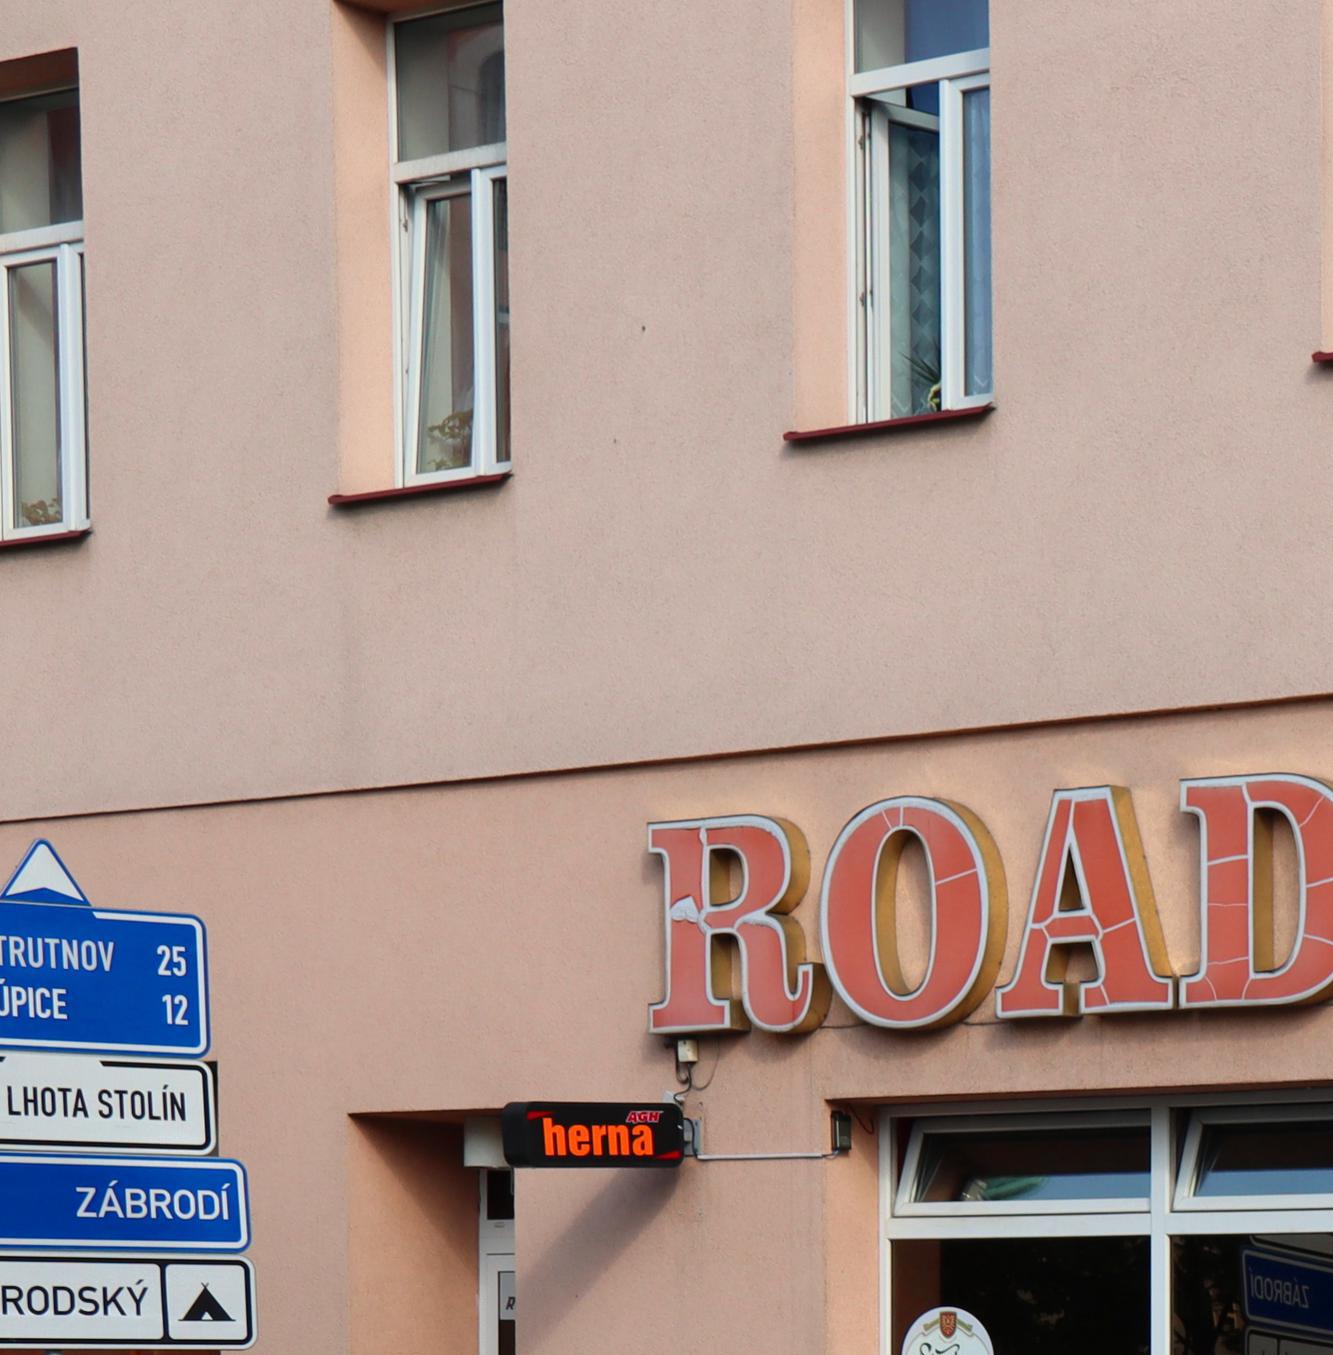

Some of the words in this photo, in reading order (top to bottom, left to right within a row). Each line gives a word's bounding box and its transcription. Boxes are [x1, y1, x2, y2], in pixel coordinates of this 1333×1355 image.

[157, 945, 188, 977] 25
[162, 994, 189, 1026] 12
[7, 1085, 89, 1118] LHOTA
[98, 1084, 187, 1121] STOLÍN
[626, 1110, 662, 1123] AGH
[543, 1117, 654, 1157] herna
[75, 1180, 230, 1220] ZÁBRODÍ
